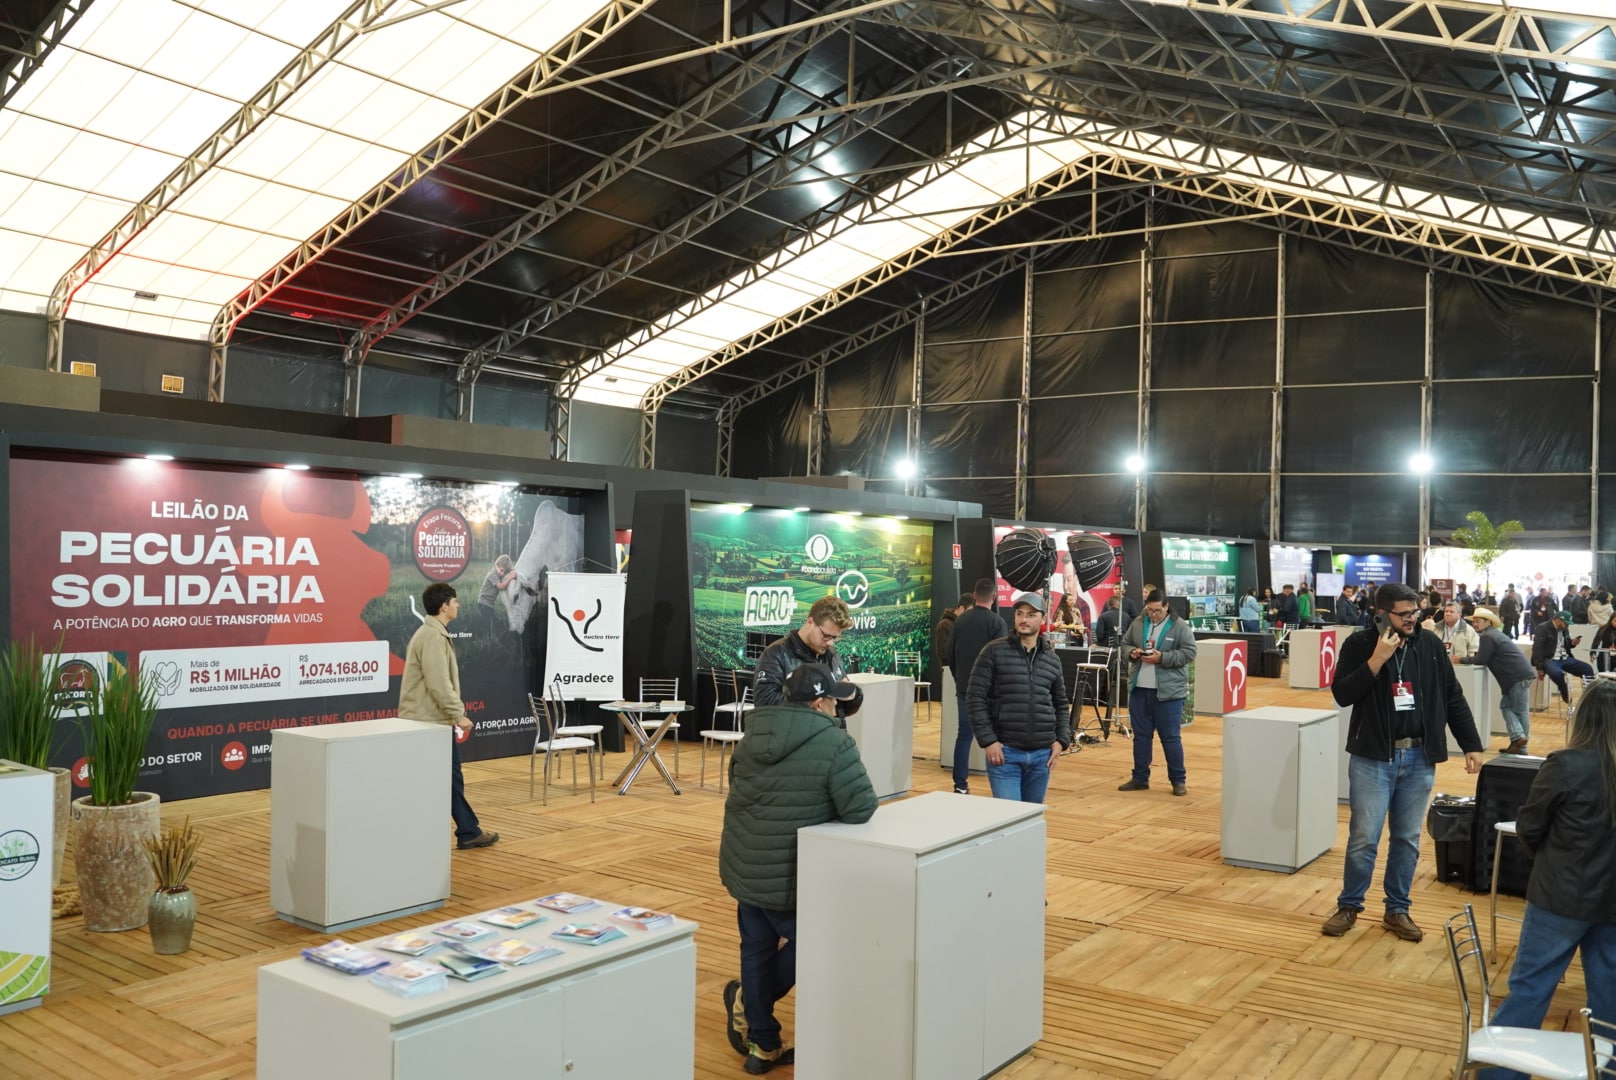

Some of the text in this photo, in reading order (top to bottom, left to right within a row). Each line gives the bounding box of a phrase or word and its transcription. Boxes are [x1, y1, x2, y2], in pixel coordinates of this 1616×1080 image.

[151, 499, 249, 521] LEILÃO DA
[60, 525, 320, 566] PECUÁRIA
[418, 531, 465, 547] Pecuária
[51, 565, 325, 607] SOLIDÁRIA
[53, 612, 323, 630] A POTÊNCIA DO AGRO QUE TRANSFORMA VIDAS
[190, 660, 220, 669] Mais de
[299, 660, 379, 678] 1,074.168,00
[190, 663, 281, 684] R$ 1 MILHÃO
[299, 677, 337, 685] ARRECADADOS
[553, 673, 614, 685] Agradece
[189, 685, 228, 693] MOBILIZADOS
[239, 681, 281, 689] SOLIDARIEDADE
[167, 724, 224, 740] QUANDO
[227, 723, 236, 734] A
[238, 716, 298, 733] PECUÁRIA
[301, 716, 315, 727] SE
[344, 711, 374, 723] QUEM
[475, 716, 536, 730] A FORÇA DO AGR
[148, 756, 164, 766] DO
[167, 751, 202, 764] SETOR
